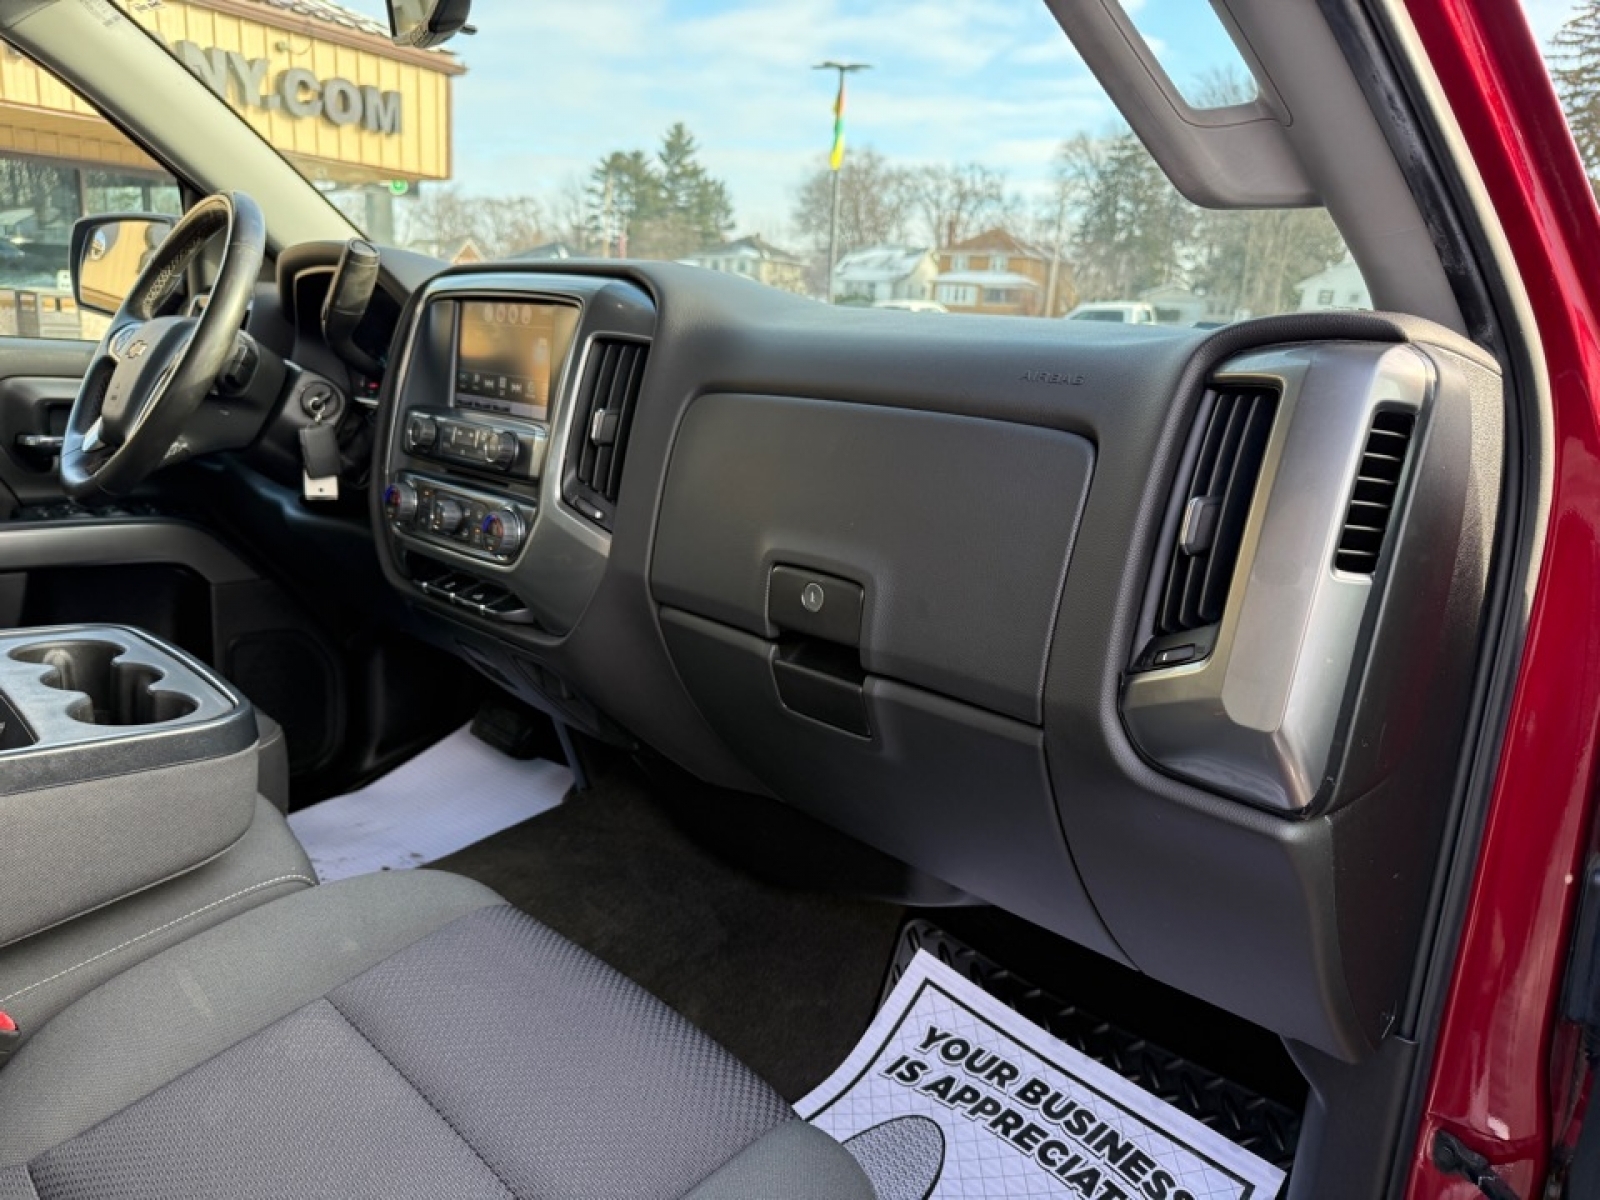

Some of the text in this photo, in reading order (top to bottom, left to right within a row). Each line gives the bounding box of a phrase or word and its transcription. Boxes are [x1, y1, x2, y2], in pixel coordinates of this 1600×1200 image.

[163, 35, 403, 136] NY.COM
[1020, 370, 1084, 386] AIRBAG
[884, 1054, 930, 1083] IS
[918, 1025, 1020, 1089] YOUR
